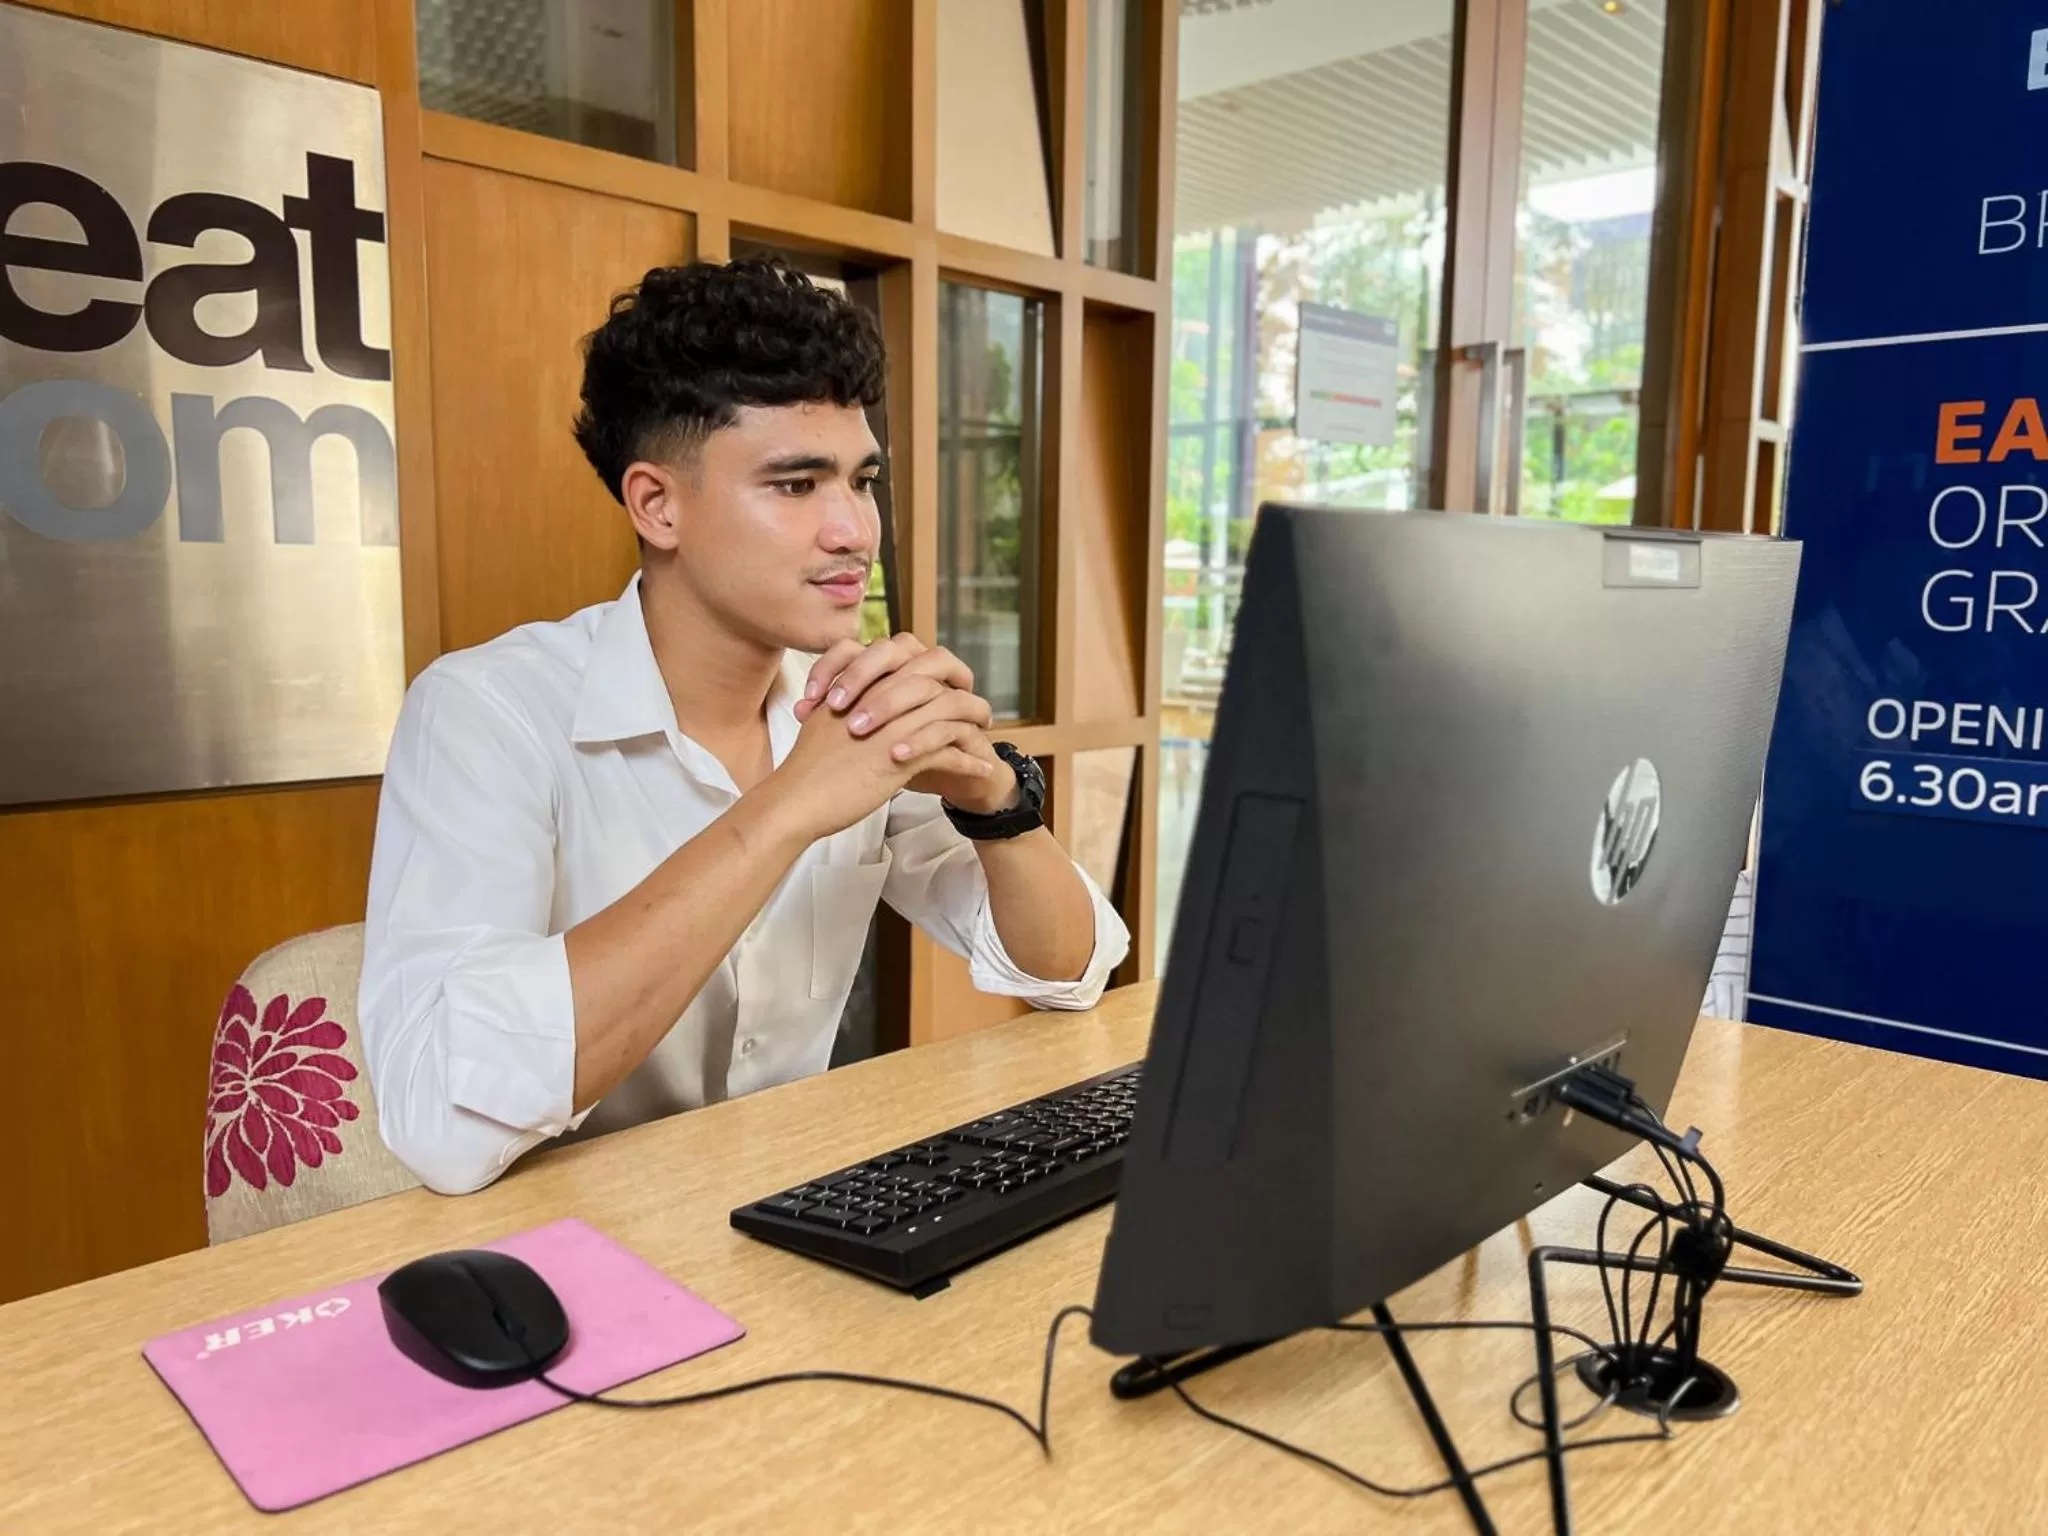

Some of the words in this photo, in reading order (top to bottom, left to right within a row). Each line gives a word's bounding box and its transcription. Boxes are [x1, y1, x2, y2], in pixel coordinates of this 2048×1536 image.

[0, 151, 391, 381] eat
[0, 379, 400, 547] om
[1935, 398, 2048, 464] EA
[1929, 485, 2048, 549] OR
[1922, 569, 2048, 633] GR
[1867, 698, 2044, 750] OPENI
[204, 1297, 352, 1352] OKER
